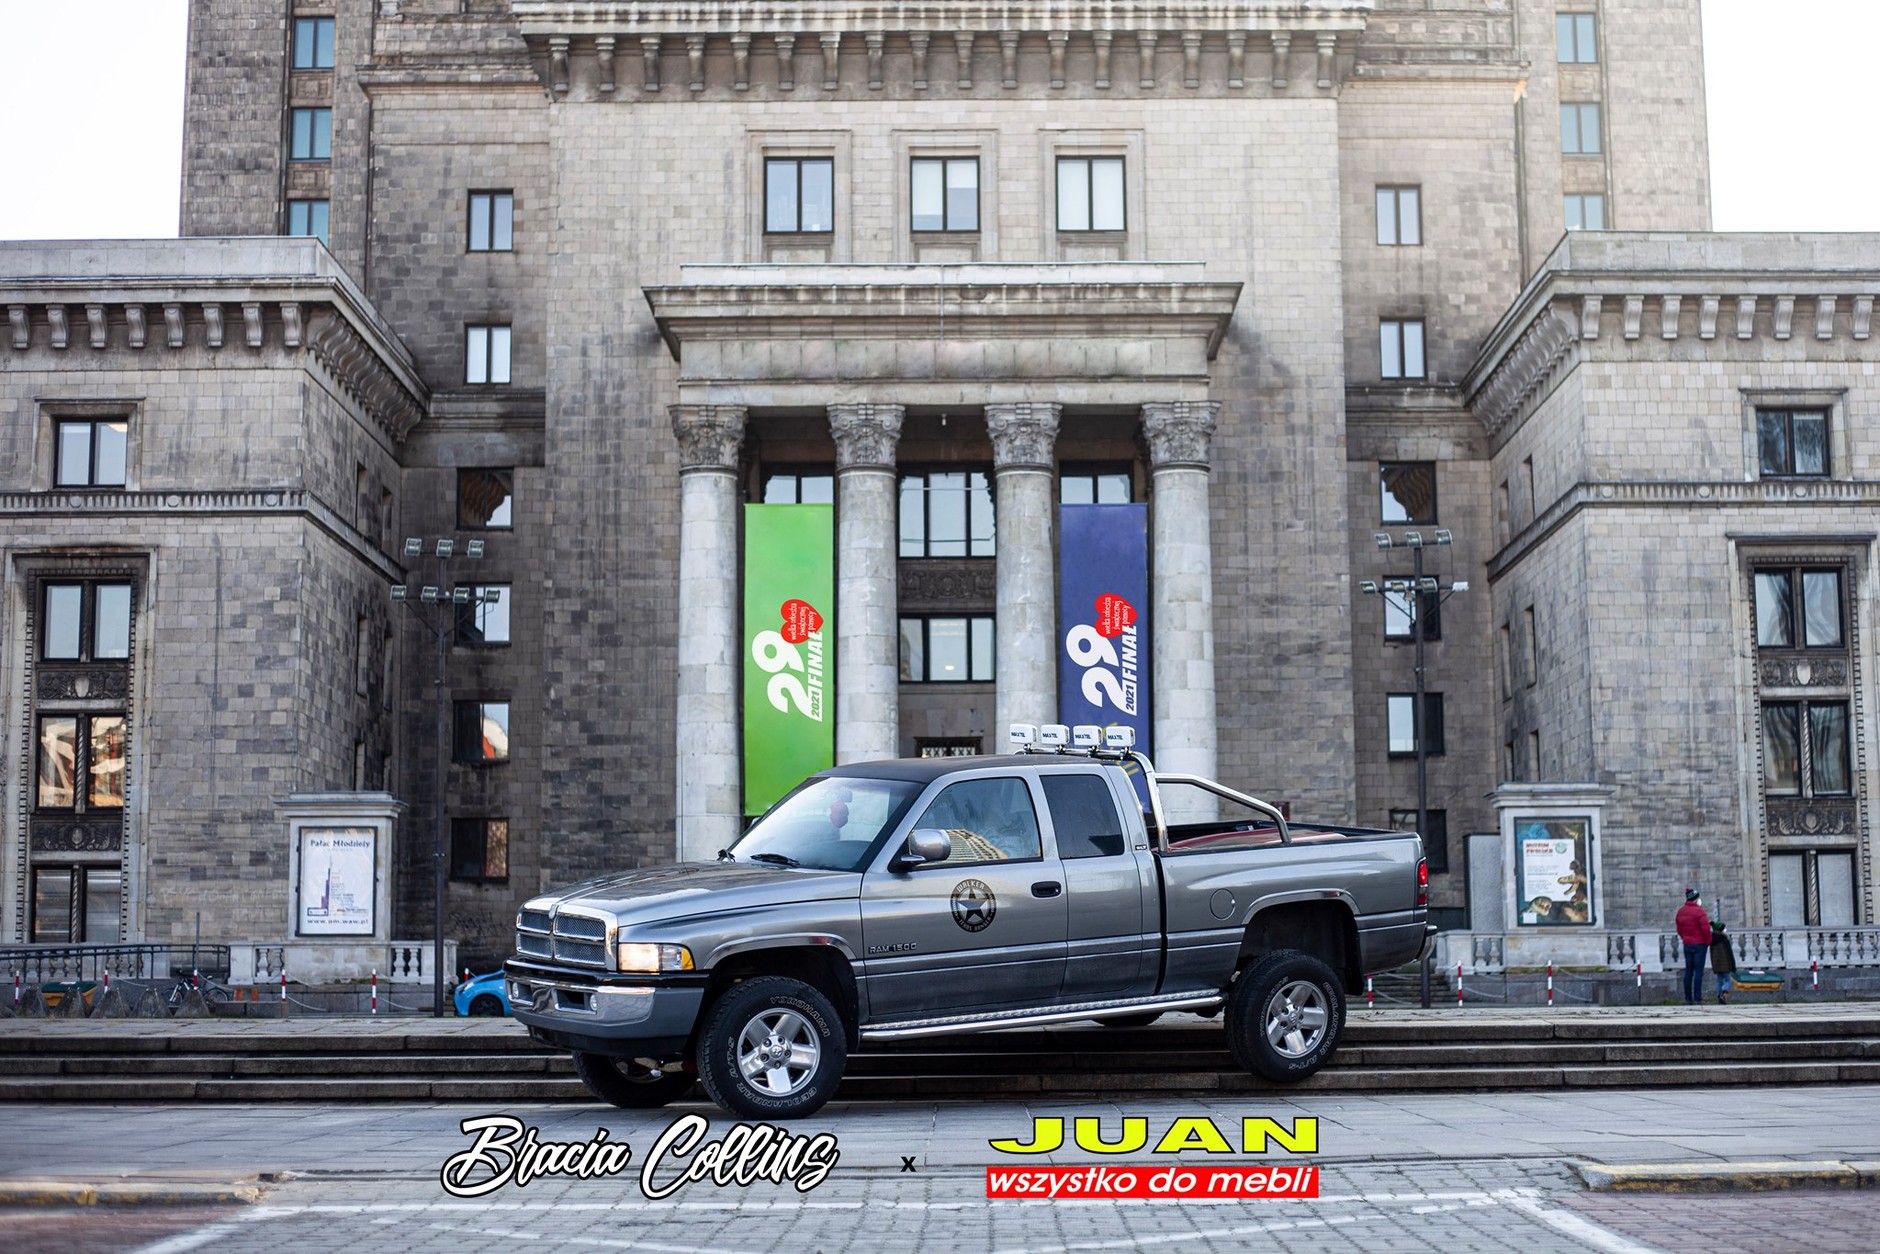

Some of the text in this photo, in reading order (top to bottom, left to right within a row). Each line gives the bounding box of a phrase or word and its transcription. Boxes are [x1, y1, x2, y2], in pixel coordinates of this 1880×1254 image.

[752, 630, 822, 722] 29
[808, 631, 823, 718] 2021 FINAŁ
[1066, 624, 1137, 716] 29
[1122, 625, 1137, 712] 2021 FINAŁ
[956, 880, 985, 893] WALKER
[869, 942, 917, 954] RAM 1500
[770, 996, 831, 1037] YOKOHAMA
[737, 1082, 817, 1107] GEOLANDAR
